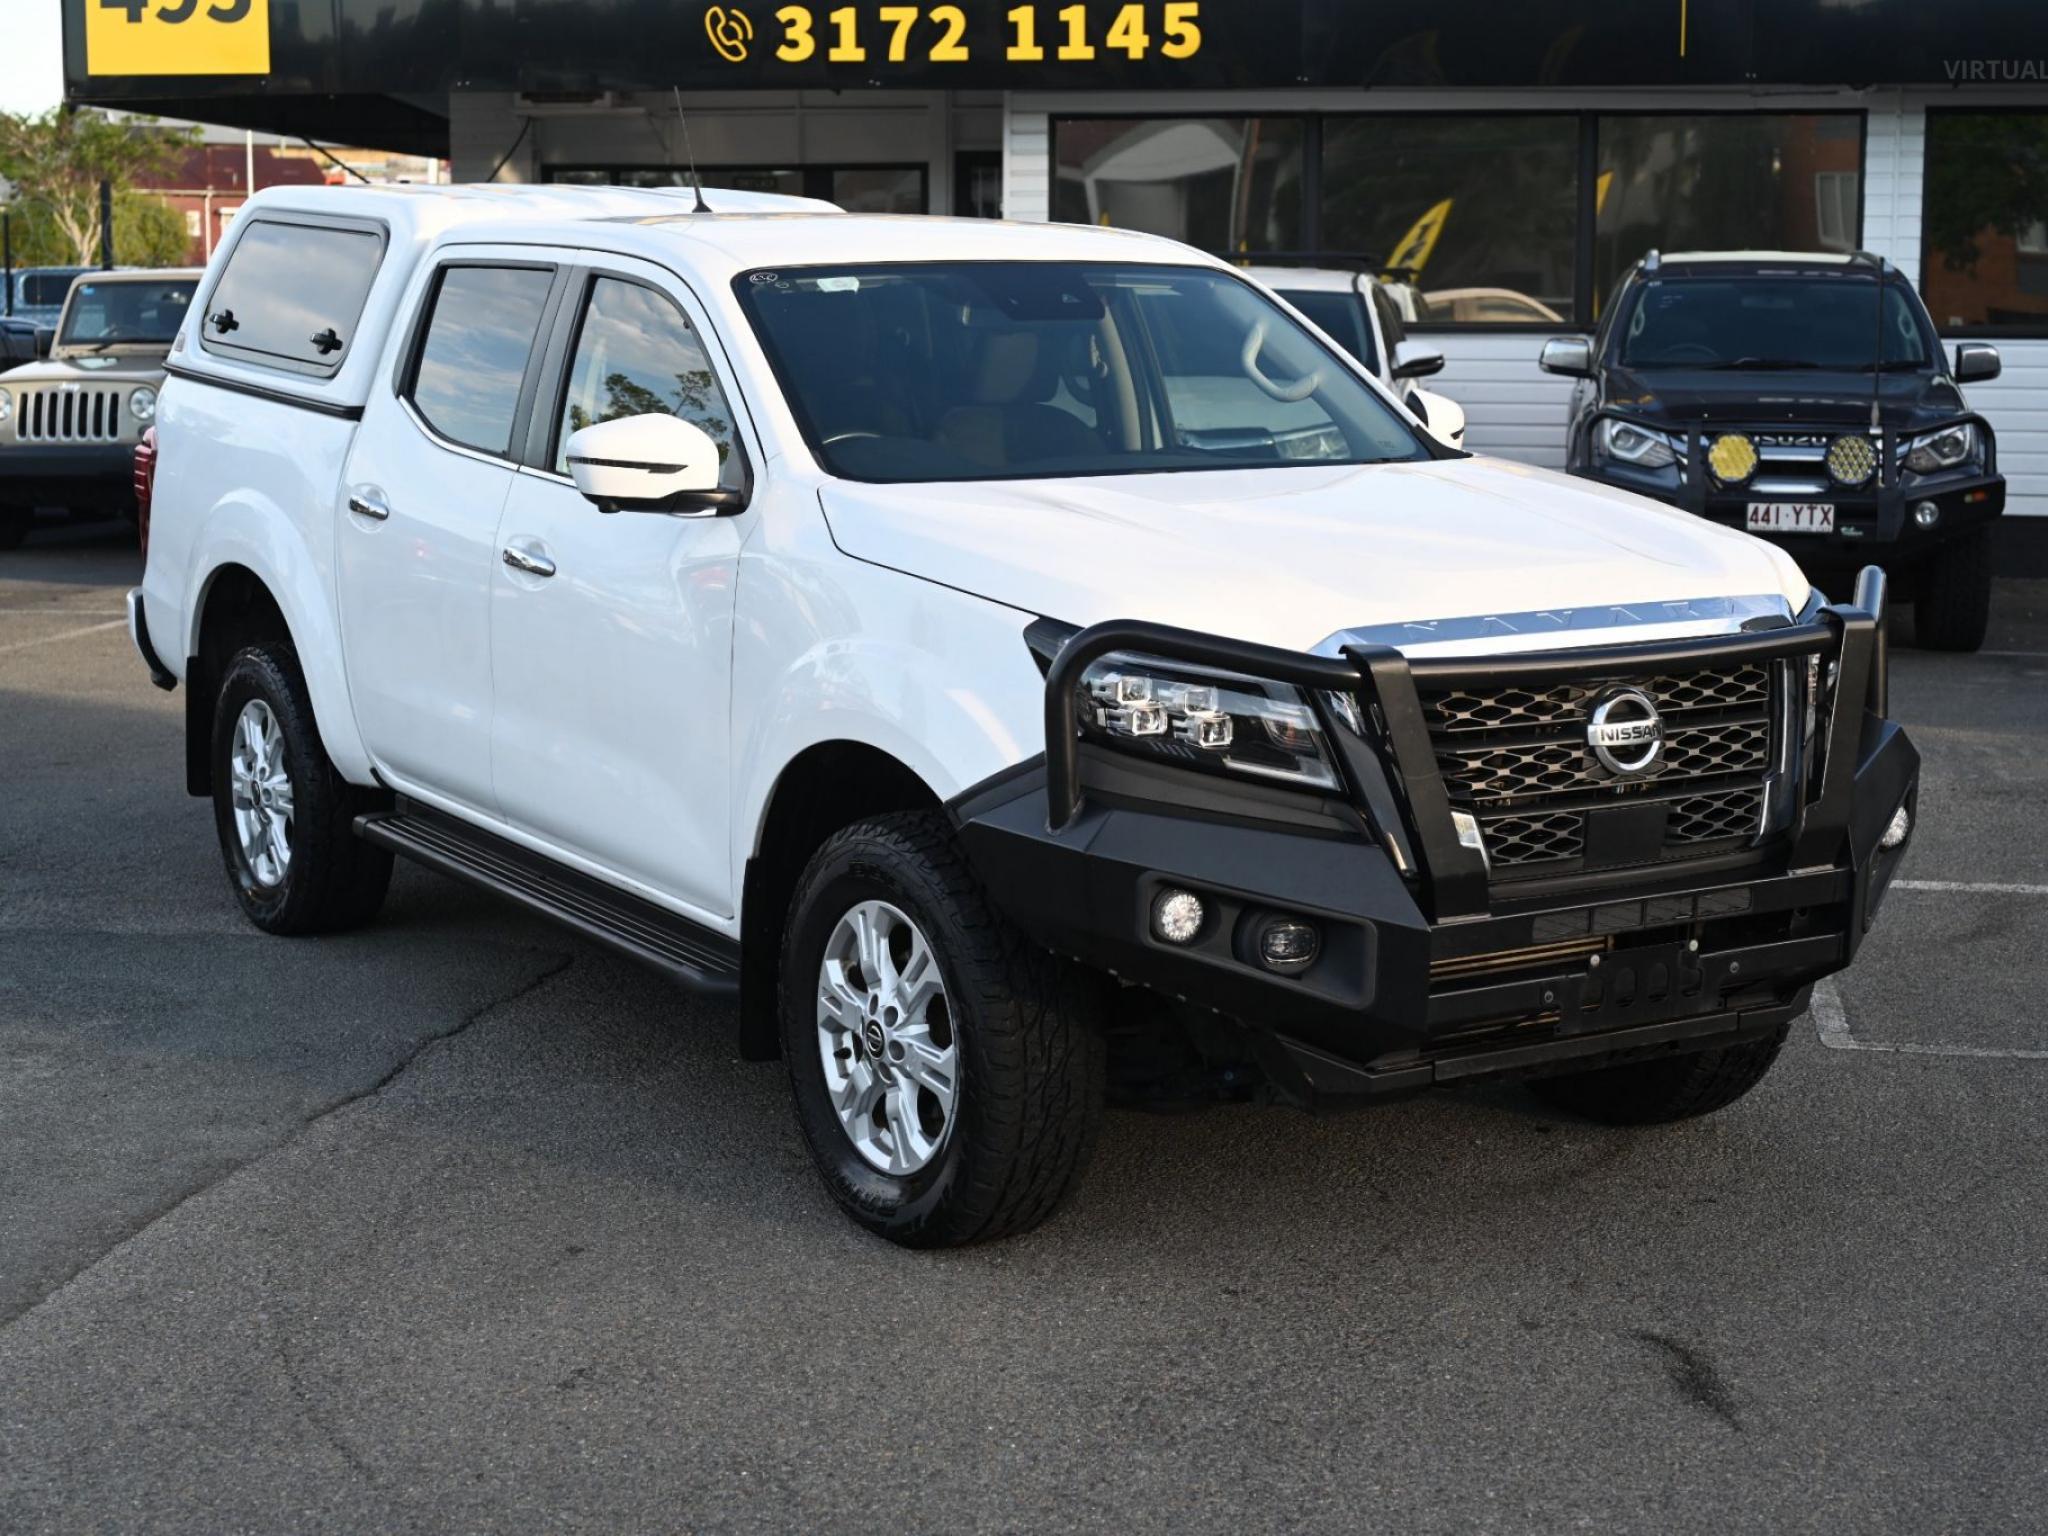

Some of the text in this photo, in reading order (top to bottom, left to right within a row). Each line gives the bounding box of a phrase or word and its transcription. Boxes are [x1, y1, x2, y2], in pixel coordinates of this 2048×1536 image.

[775, 2, 1201, 63] 3172 1145
[1753, 436, 1827, 446] ISUZU
[1600, 724, 1663, 742] NISSAN
